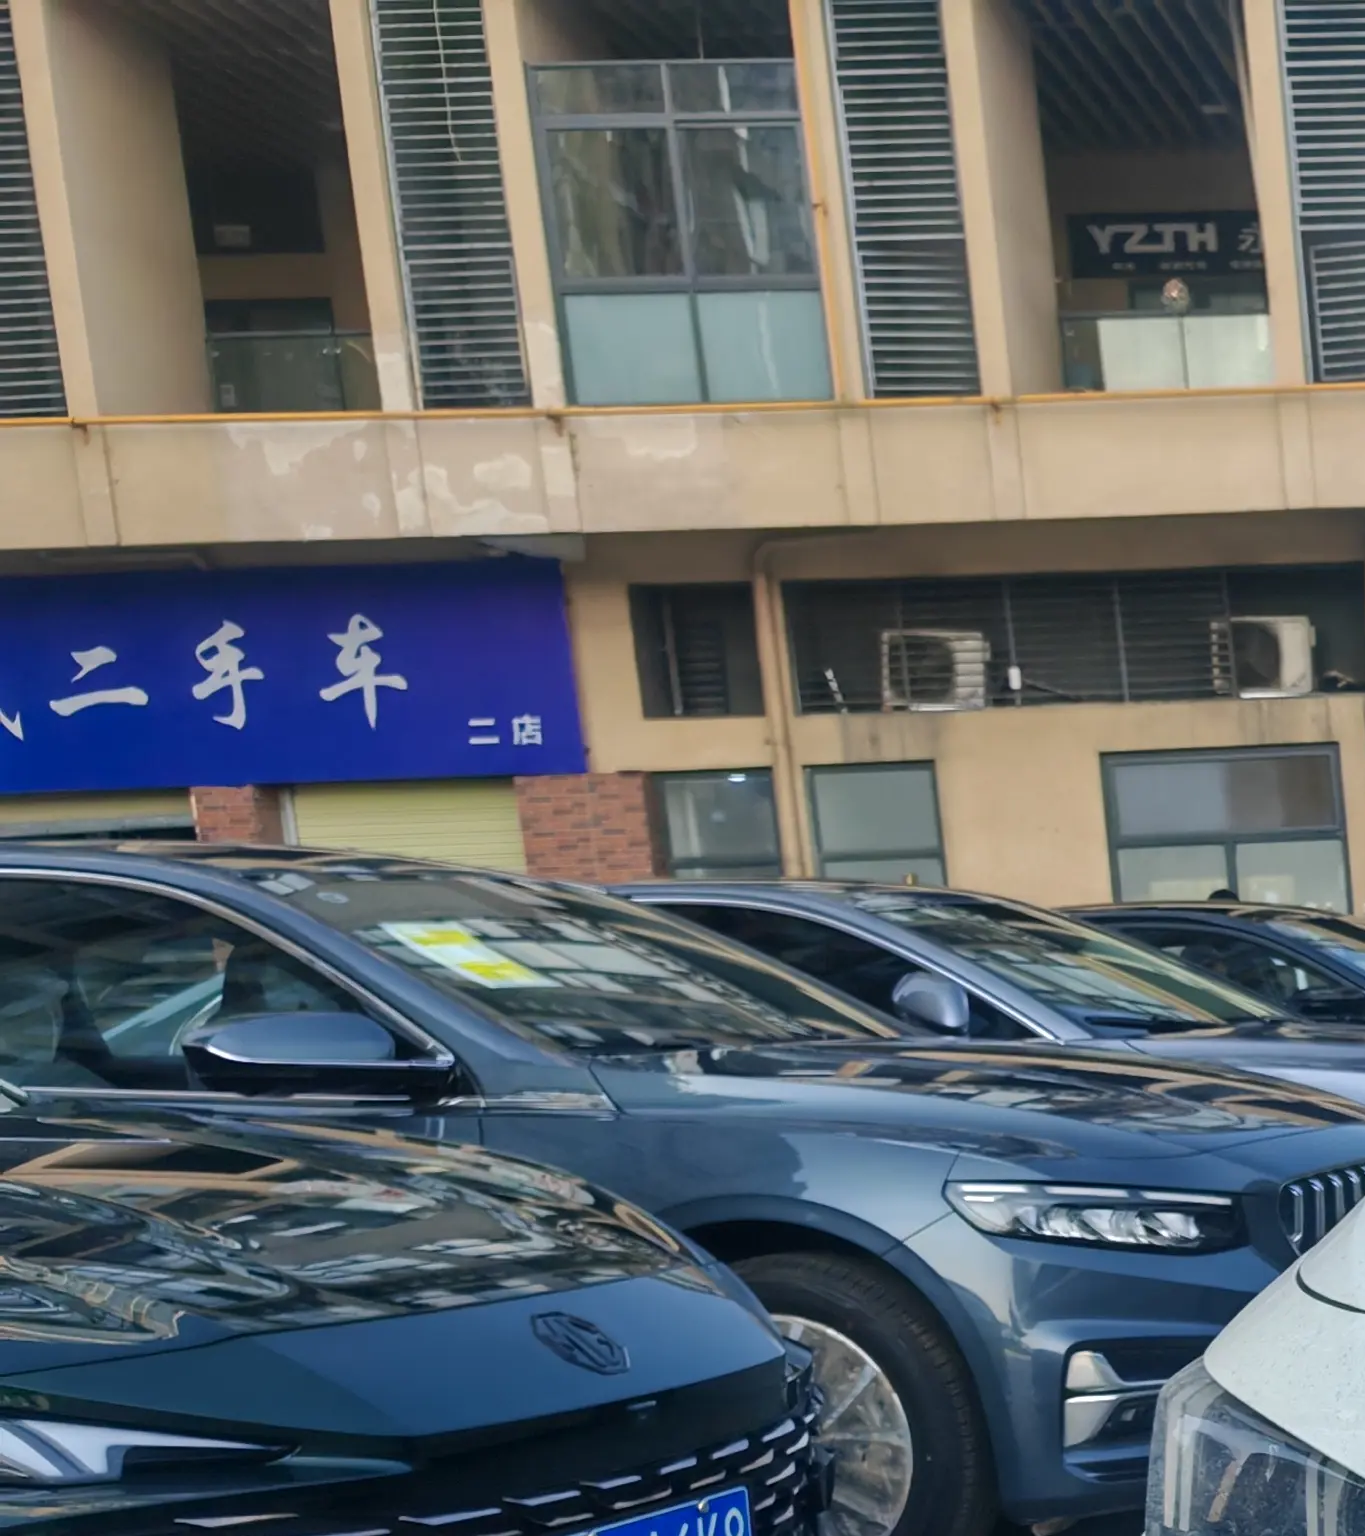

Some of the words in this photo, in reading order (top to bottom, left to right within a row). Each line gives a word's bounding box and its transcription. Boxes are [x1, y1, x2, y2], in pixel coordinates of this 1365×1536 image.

[1086, 222, 1218, 253] YZTH
[0, 613, 407, 741] 二手车
[467, 714, 542, 746] 二店
